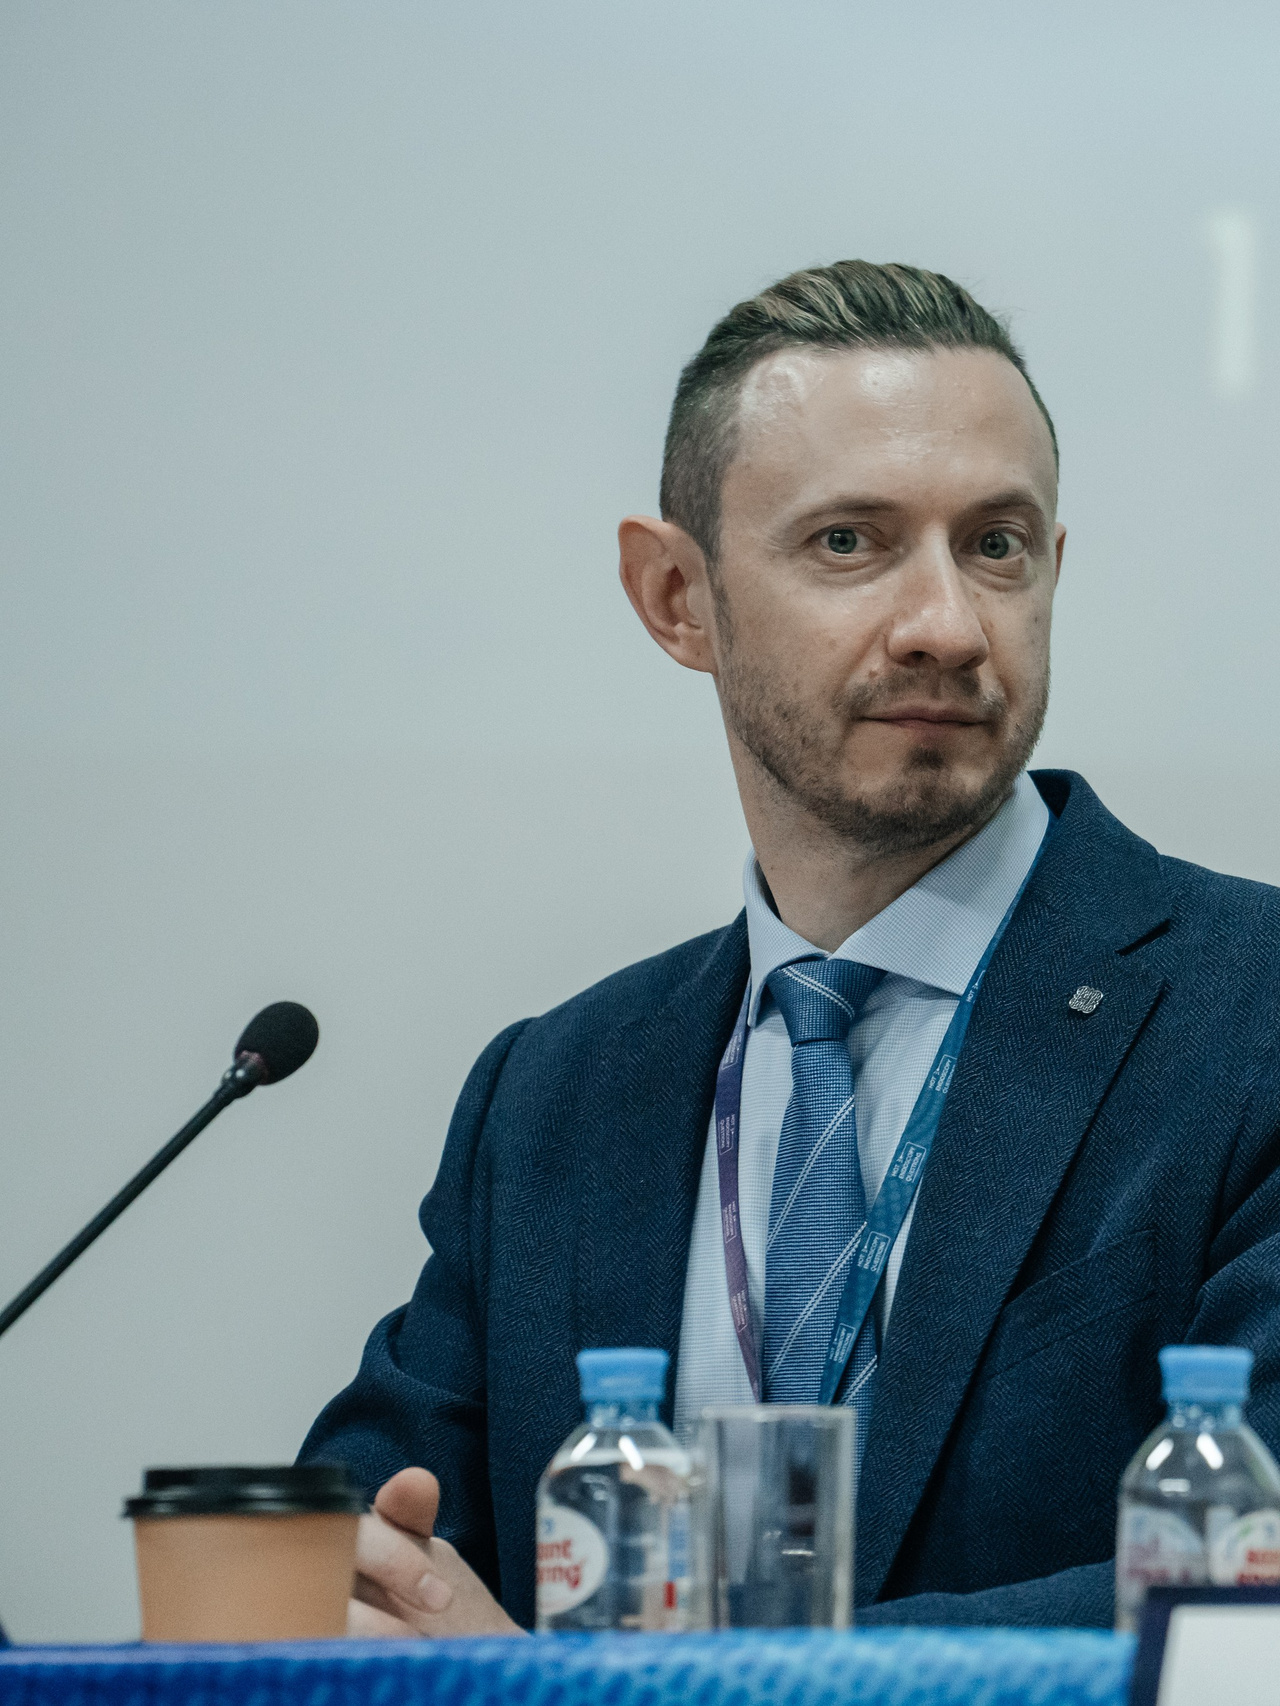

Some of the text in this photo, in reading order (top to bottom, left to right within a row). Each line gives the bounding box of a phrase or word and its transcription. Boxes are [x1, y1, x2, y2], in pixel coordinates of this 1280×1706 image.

[928, 1076, 937, 1089] HOT
[935, 1058, 952, 1092] ENDOSCOPY
[891, 1163, 900, 1177] HOT
[898, 1146, 915, 1180] ENDOSCOPY
[905, 1152, 922, 1182] QUESTIONS
[857, 1253, 866, 1267] HOT
[863, 1235, 880, 1270] ENDOSCOPY
[870, 1241, 886, 1272] QUESTIONS
